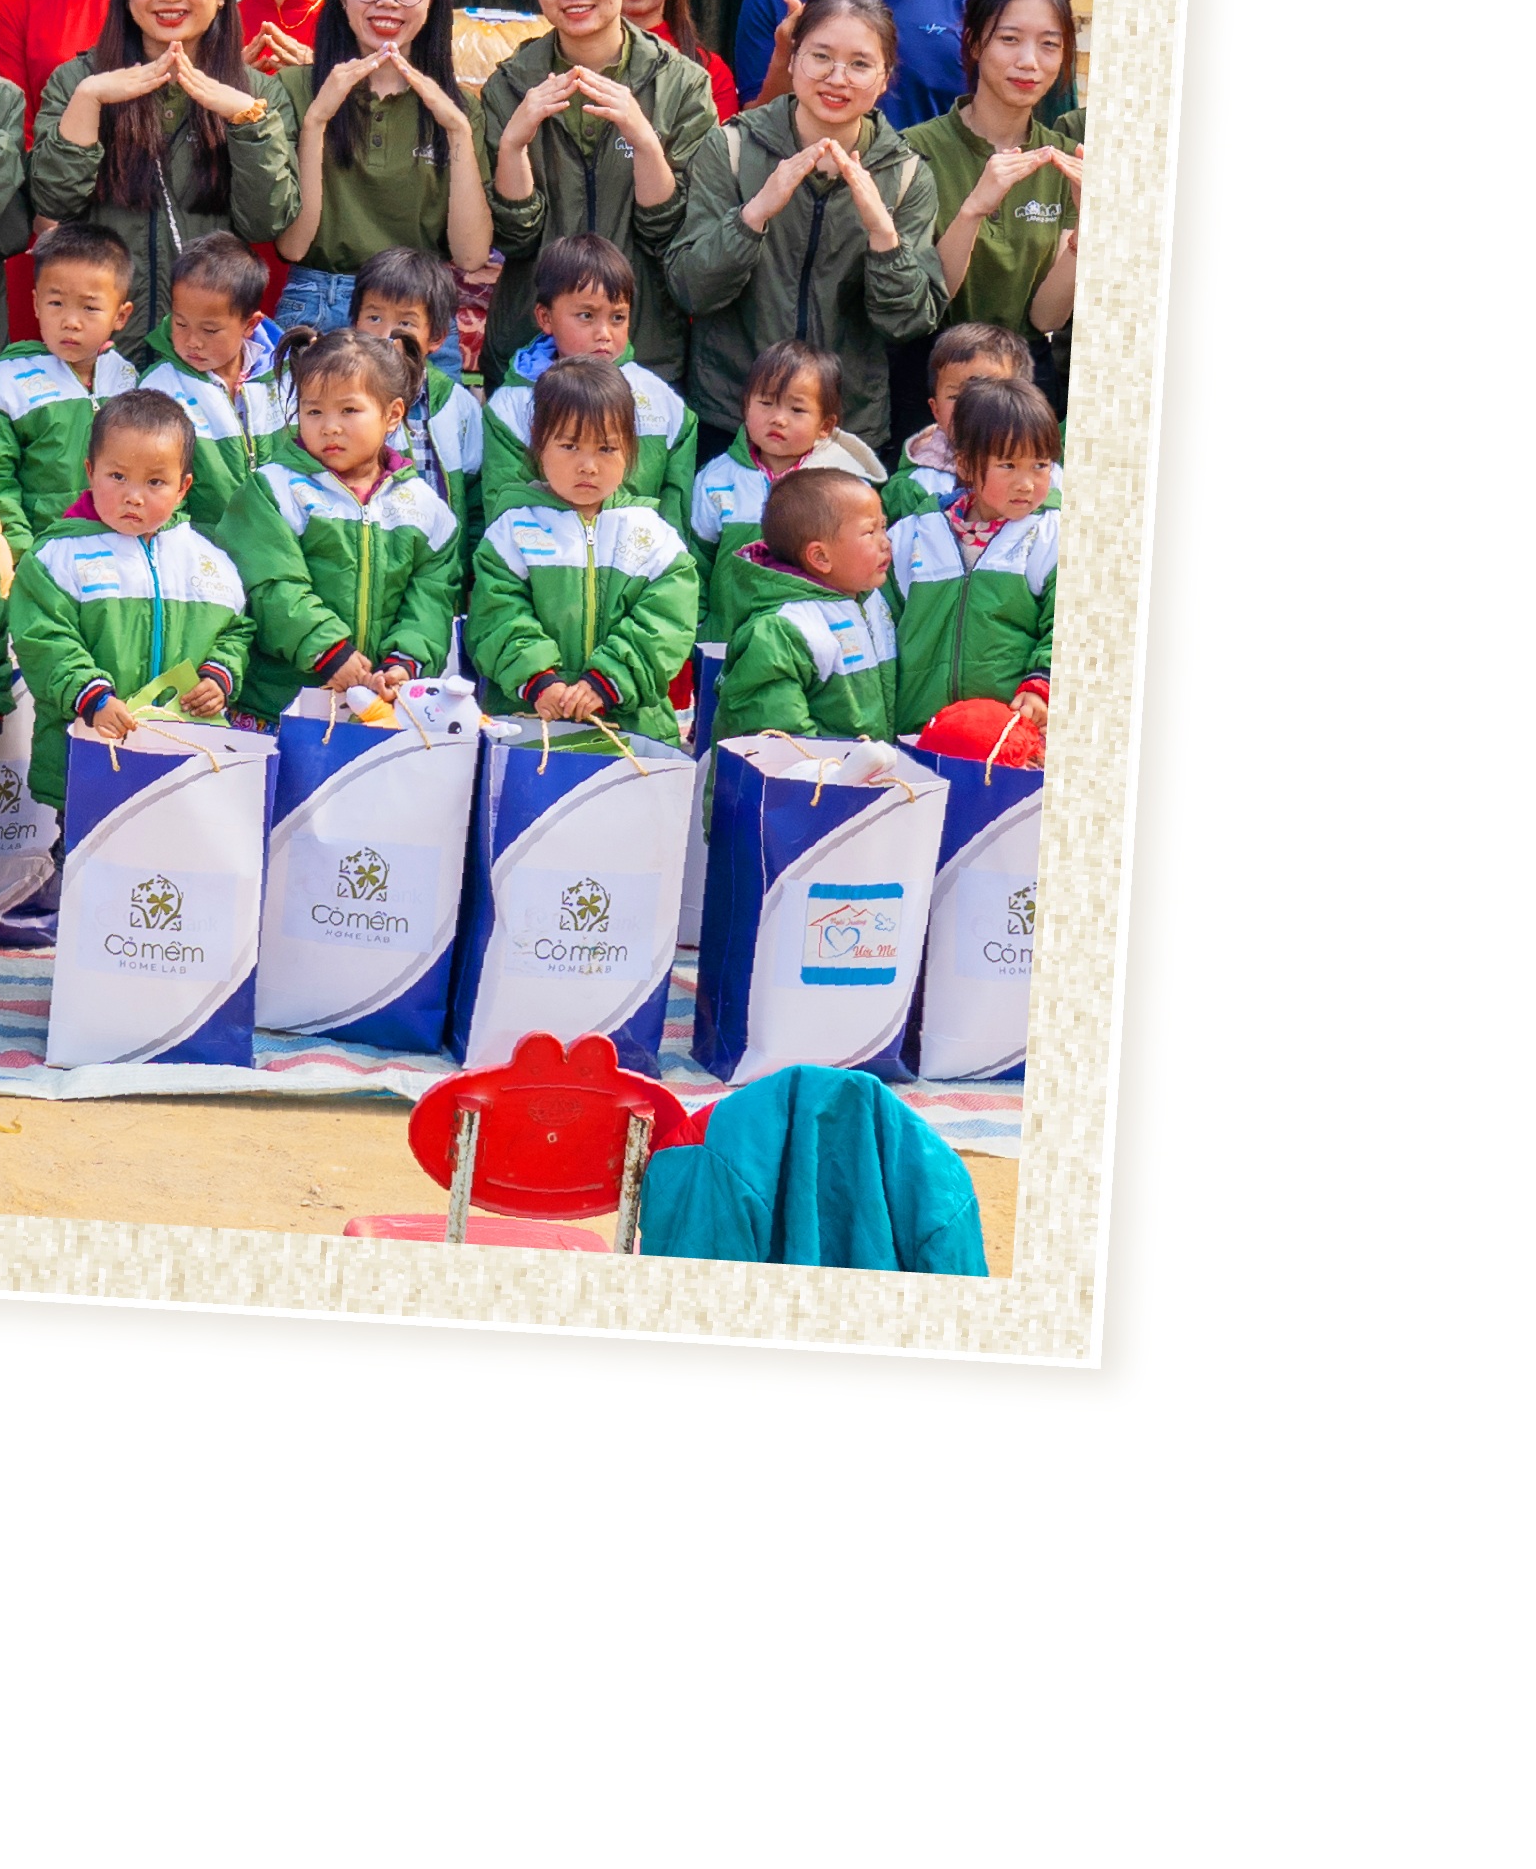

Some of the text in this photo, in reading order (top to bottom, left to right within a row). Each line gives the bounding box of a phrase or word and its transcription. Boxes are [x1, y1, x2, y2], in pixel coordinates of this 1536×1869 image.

[312, 904, 408, 933] Cỏ mềm
[325, 929, 390, 944] HOME LAB
[104, 934, 204, 963] Cỏ mềm
[535, 938, 628, 962] Cỏ mềm
[984, 941, 1016, 963] Cỏ
[119, 960, 187, 975] HOME LAB
[547, 963, 586, 973] HOME
